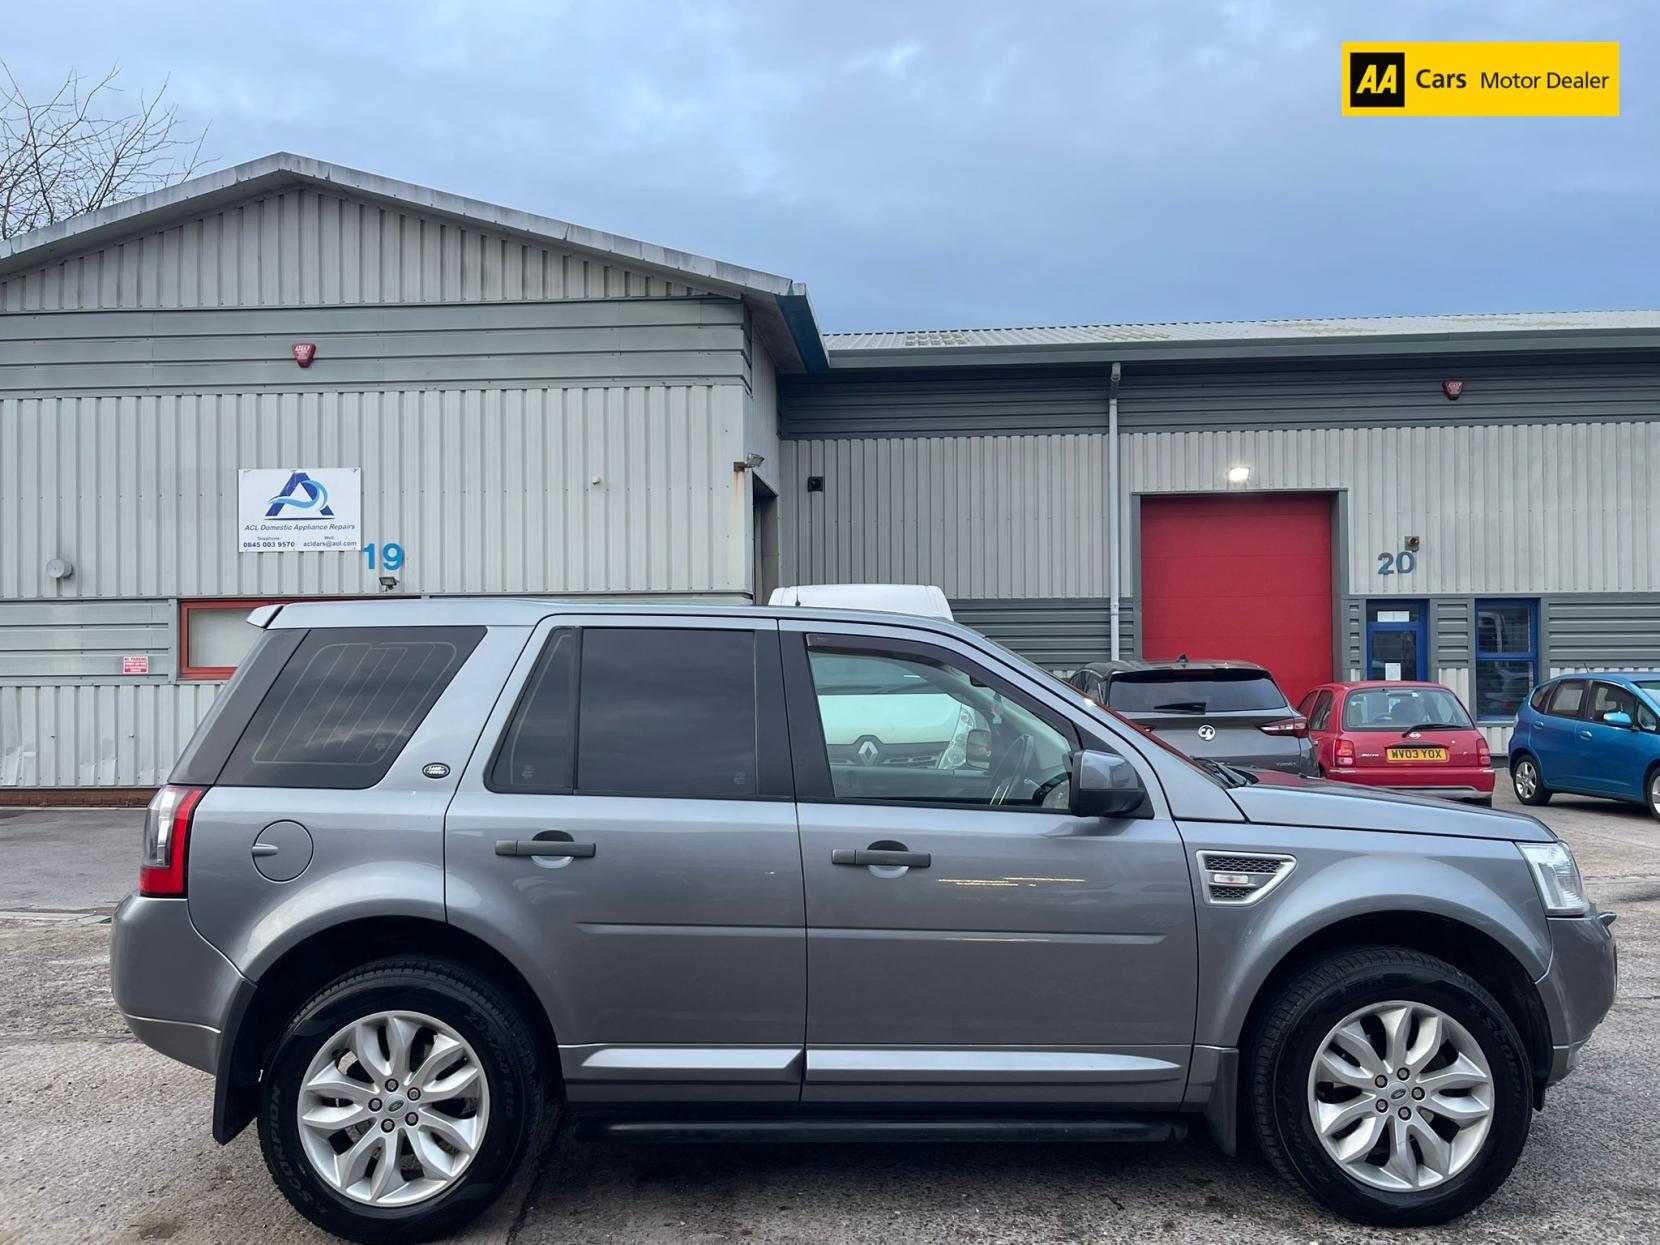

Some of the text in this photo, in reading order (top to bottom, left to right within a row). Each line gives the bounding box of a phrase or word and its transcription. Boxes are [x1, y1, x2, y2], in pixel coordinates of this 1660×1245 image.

[362, 542, 405, 571] 19
[1377, 551, 1415, 575] 20
[1391, 749, 1419, 759] WV03
[1421, 749, 1442, 759] YOX
